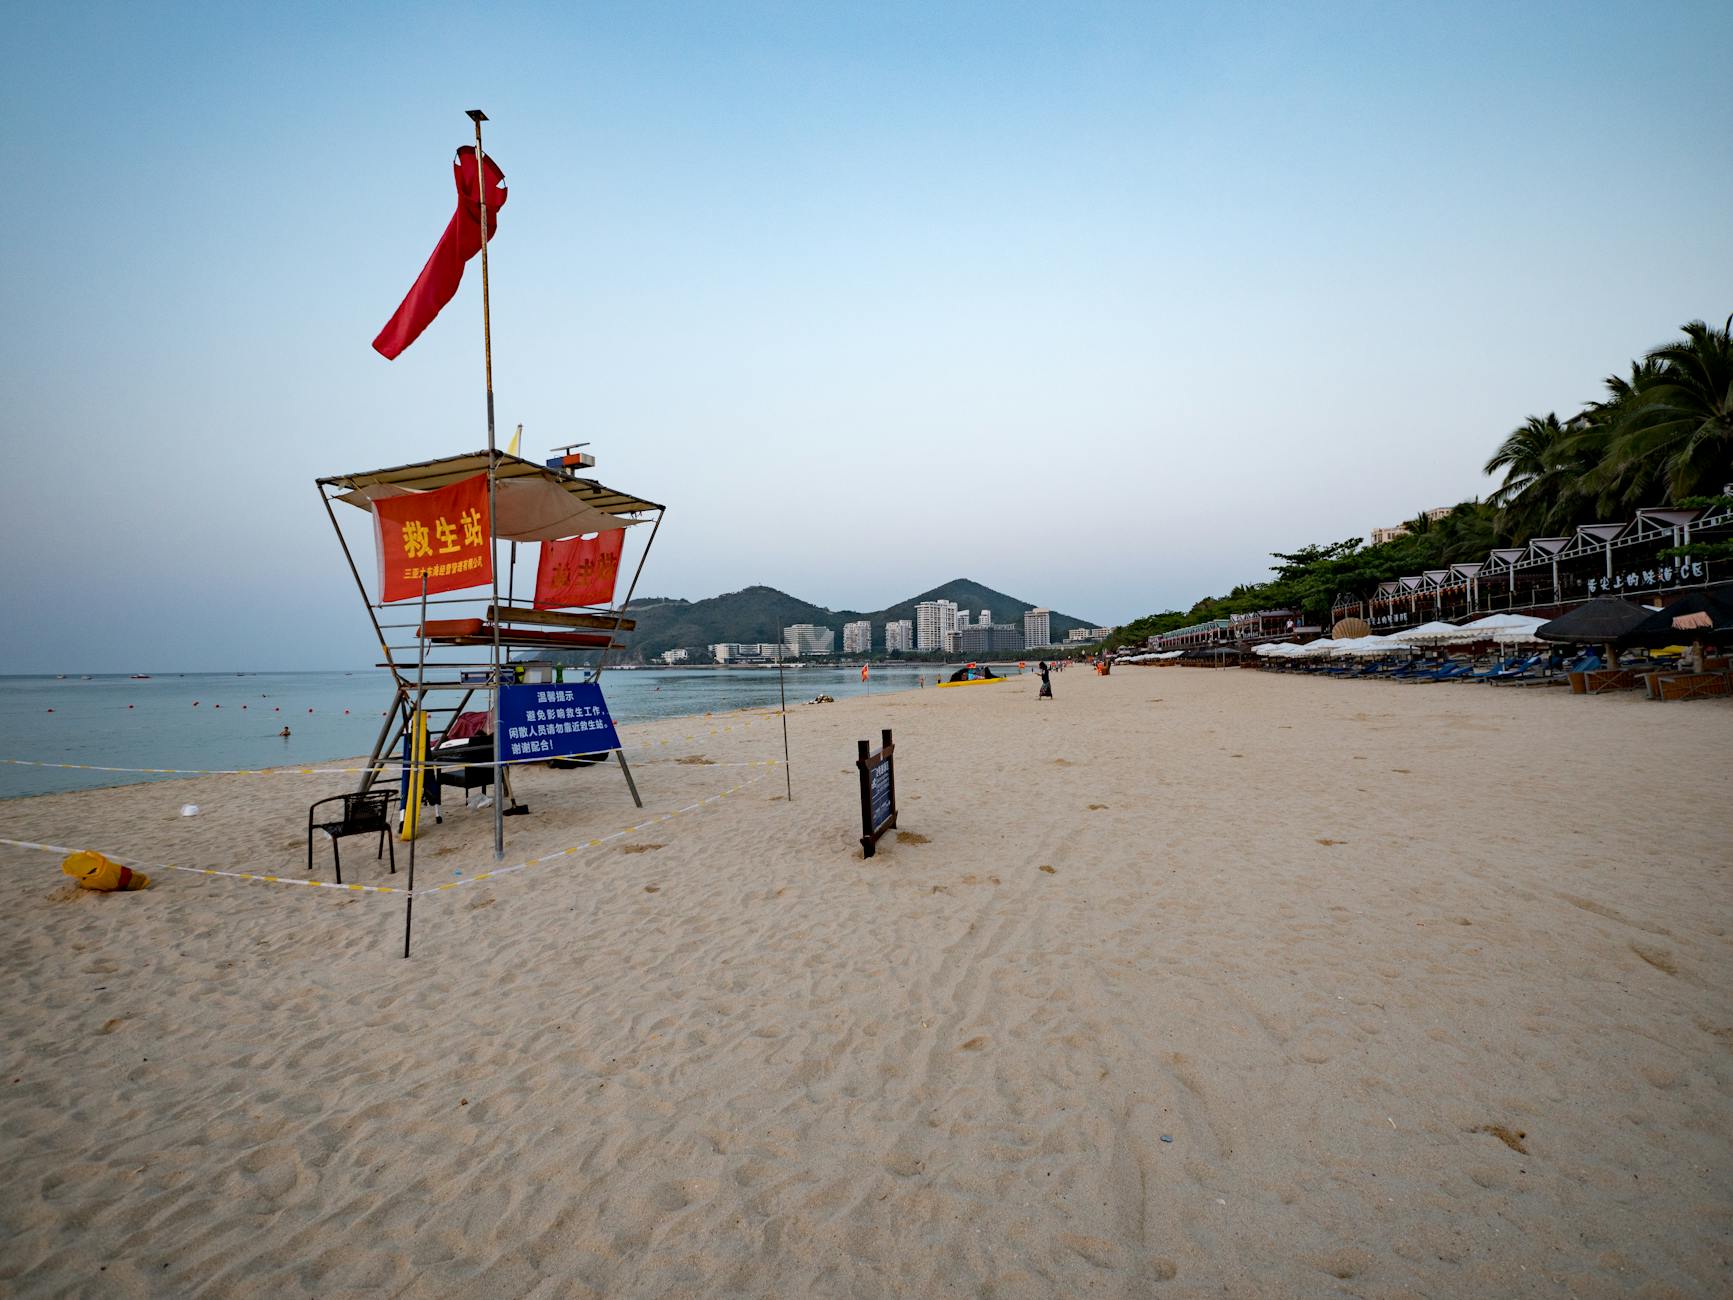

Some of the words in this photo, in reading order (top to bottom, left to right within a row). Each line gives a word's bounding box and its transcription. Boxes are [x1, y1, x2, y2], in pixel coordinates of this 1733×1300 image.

[402, 507, 483, 558] 救生站
[537, 690, 575, 703] 温馨提示
